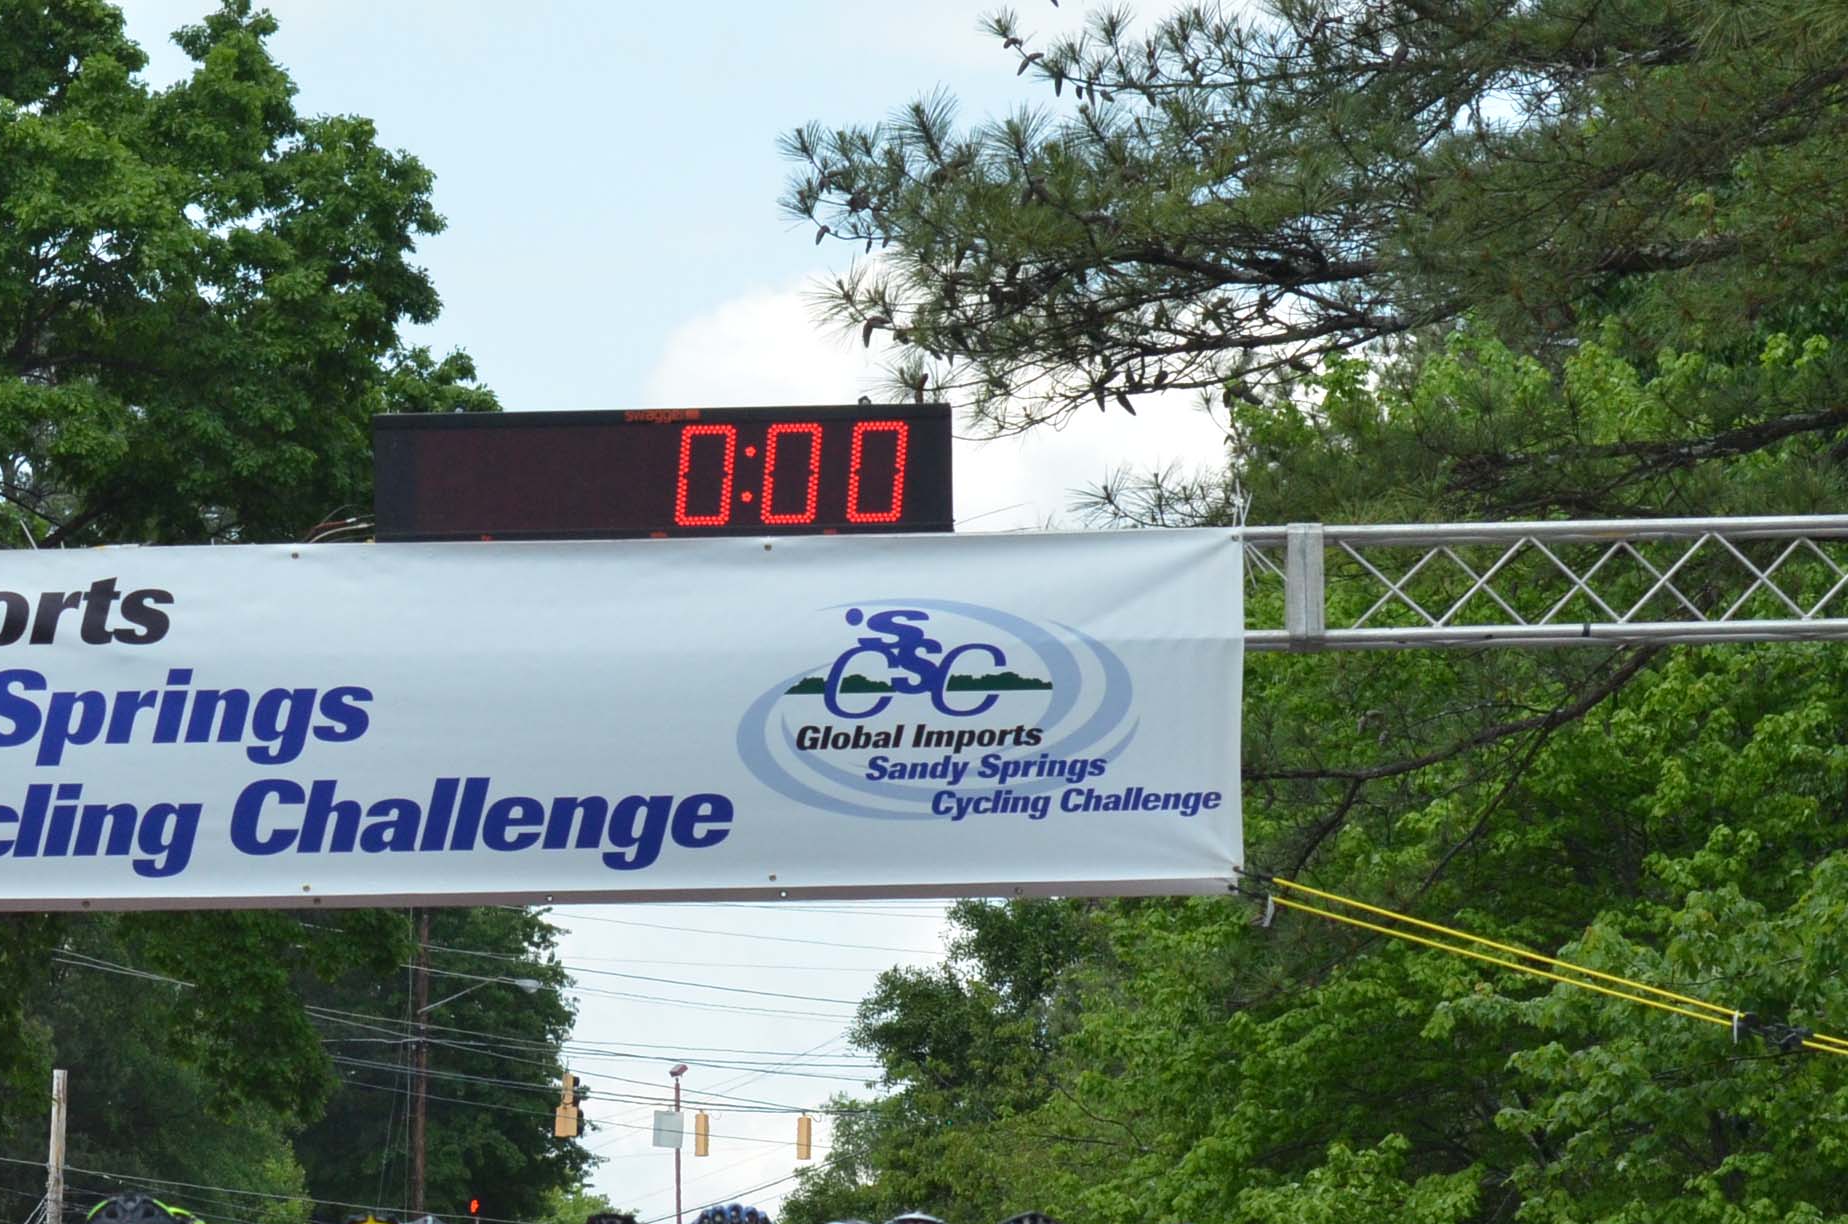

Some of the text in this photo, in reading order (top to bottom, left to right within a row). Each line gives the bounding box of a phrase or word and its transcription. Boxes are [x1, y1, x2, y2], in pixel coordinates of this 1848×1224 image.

[796, 724, 1043, 753] Global Imports
[866, 754, 1107, 785] Sandy Springs
[932, 787, 1221, 821] Cycling Challenge
[231, 777, 733, 870] Challenge
